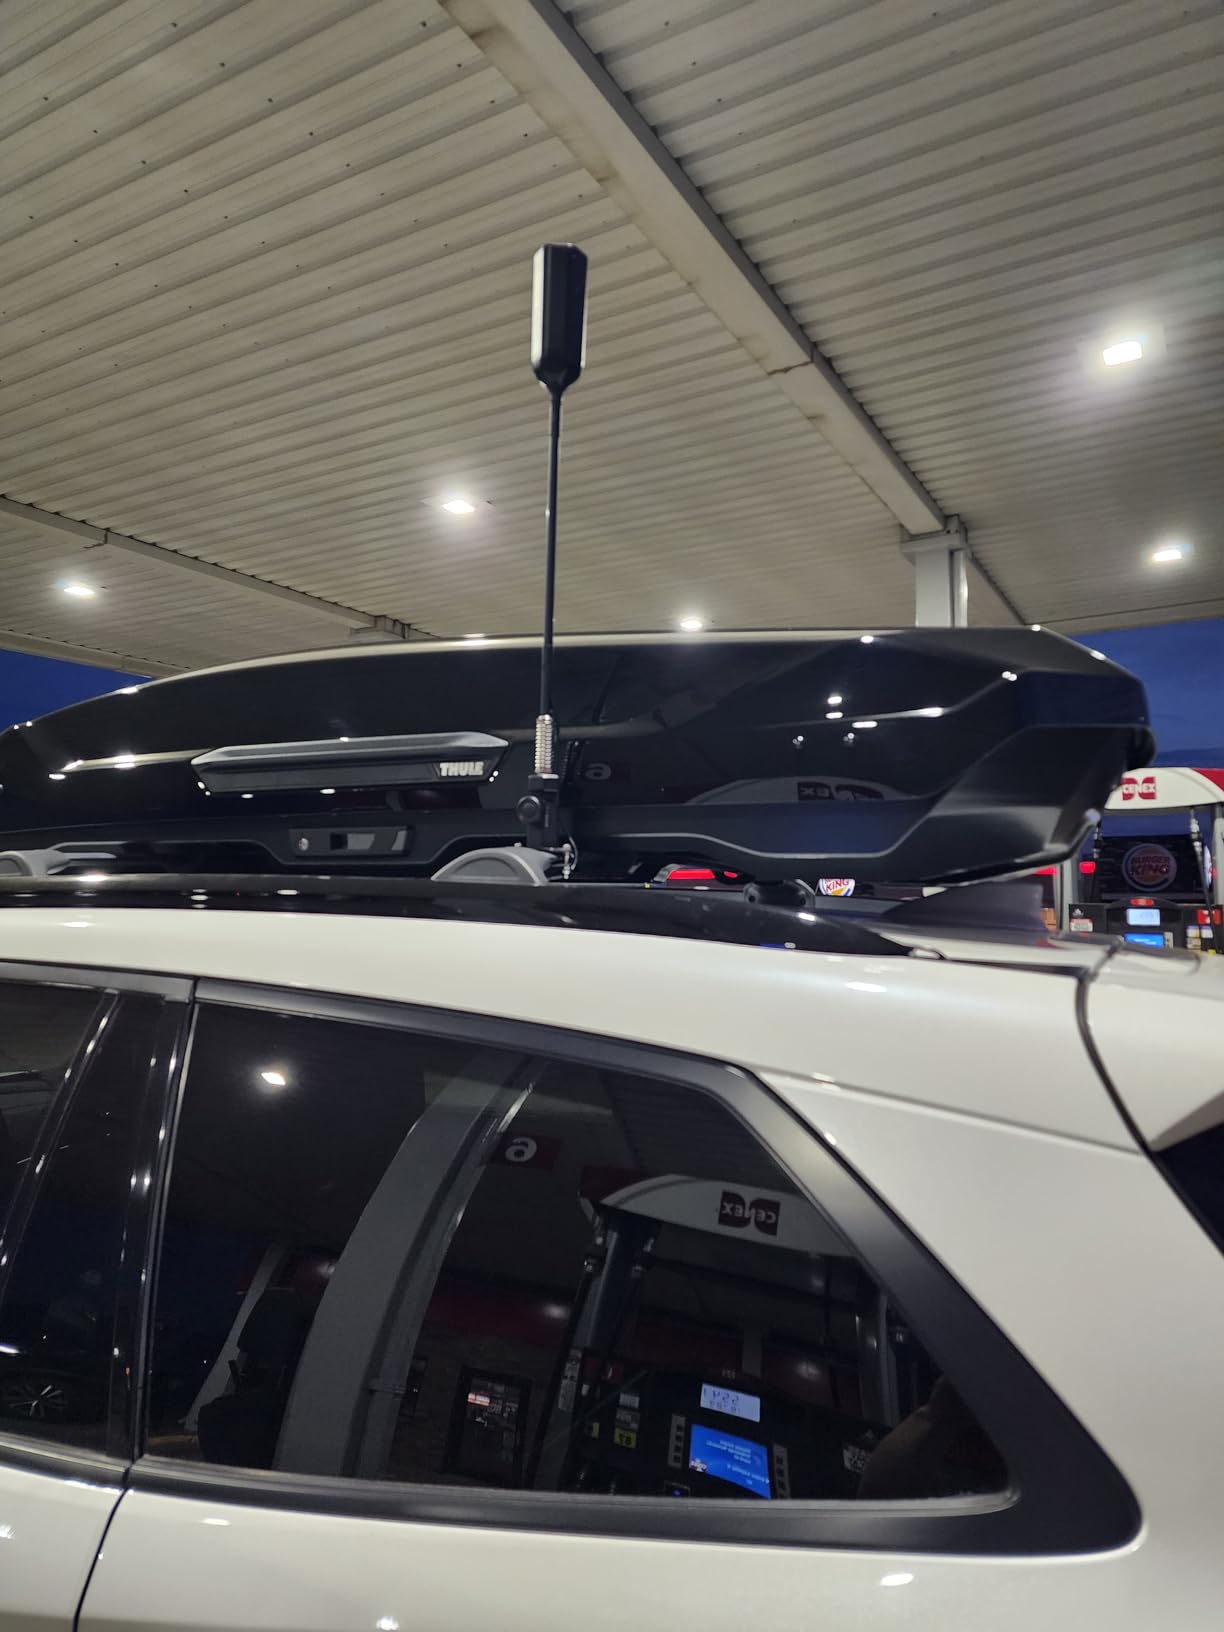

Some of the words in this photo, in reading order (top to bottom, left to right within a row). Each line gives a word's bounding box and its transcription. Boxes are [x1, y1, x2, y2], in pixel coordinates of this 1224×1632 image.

[439, 761, 484, 777] THULE
[1121, 781, 1156, 795] CENEX
[822, 878, 849, 893] KING
